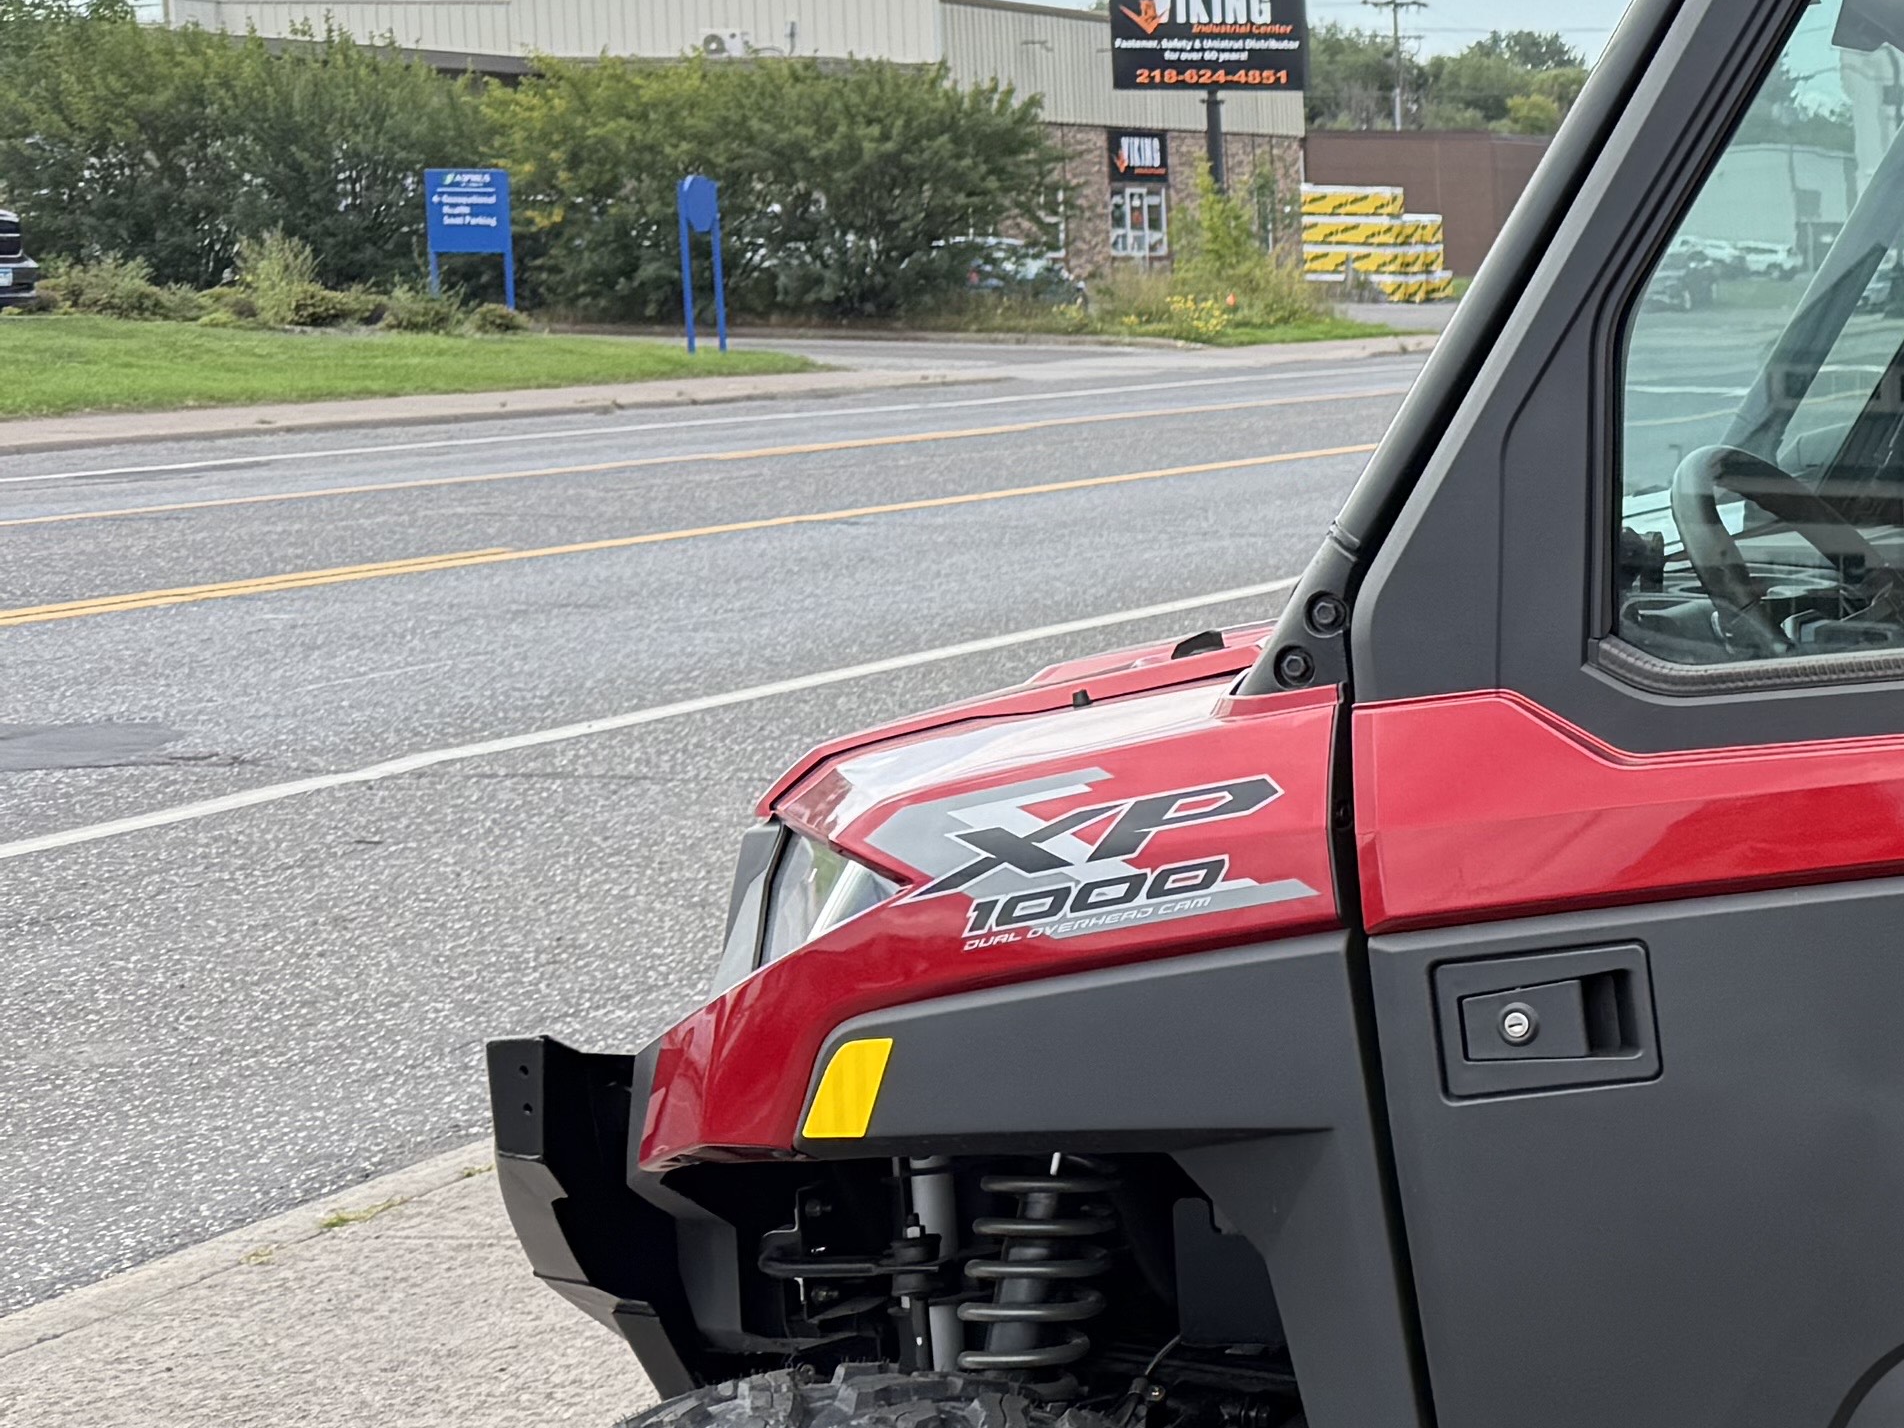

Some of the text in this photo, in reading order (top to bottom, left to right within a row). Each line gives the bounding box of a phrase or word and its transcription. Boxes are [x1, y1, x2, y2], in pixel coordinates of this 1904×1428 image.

[1191, 23, 1293, 35] Industrial Center
[1160, 38, 1192, 51] Safety
[1194, 39, 1201, 49] &
[1245, 38, 1300, 50] Distributor
[1164, 51, 1179, 61] for
[1180, 52, 1202, 61] over
[1218, 51, 1249, 63] years!
[1136, 68, 1288, 85] 218-624-4851
[1121, 136, 1160, 167] VIKING
[890, 773, 1285, 908] XP
[962, 853, 1230, 939] 1000
[962, 895, 1212, 953] DUAL OVERHEAD CAM
